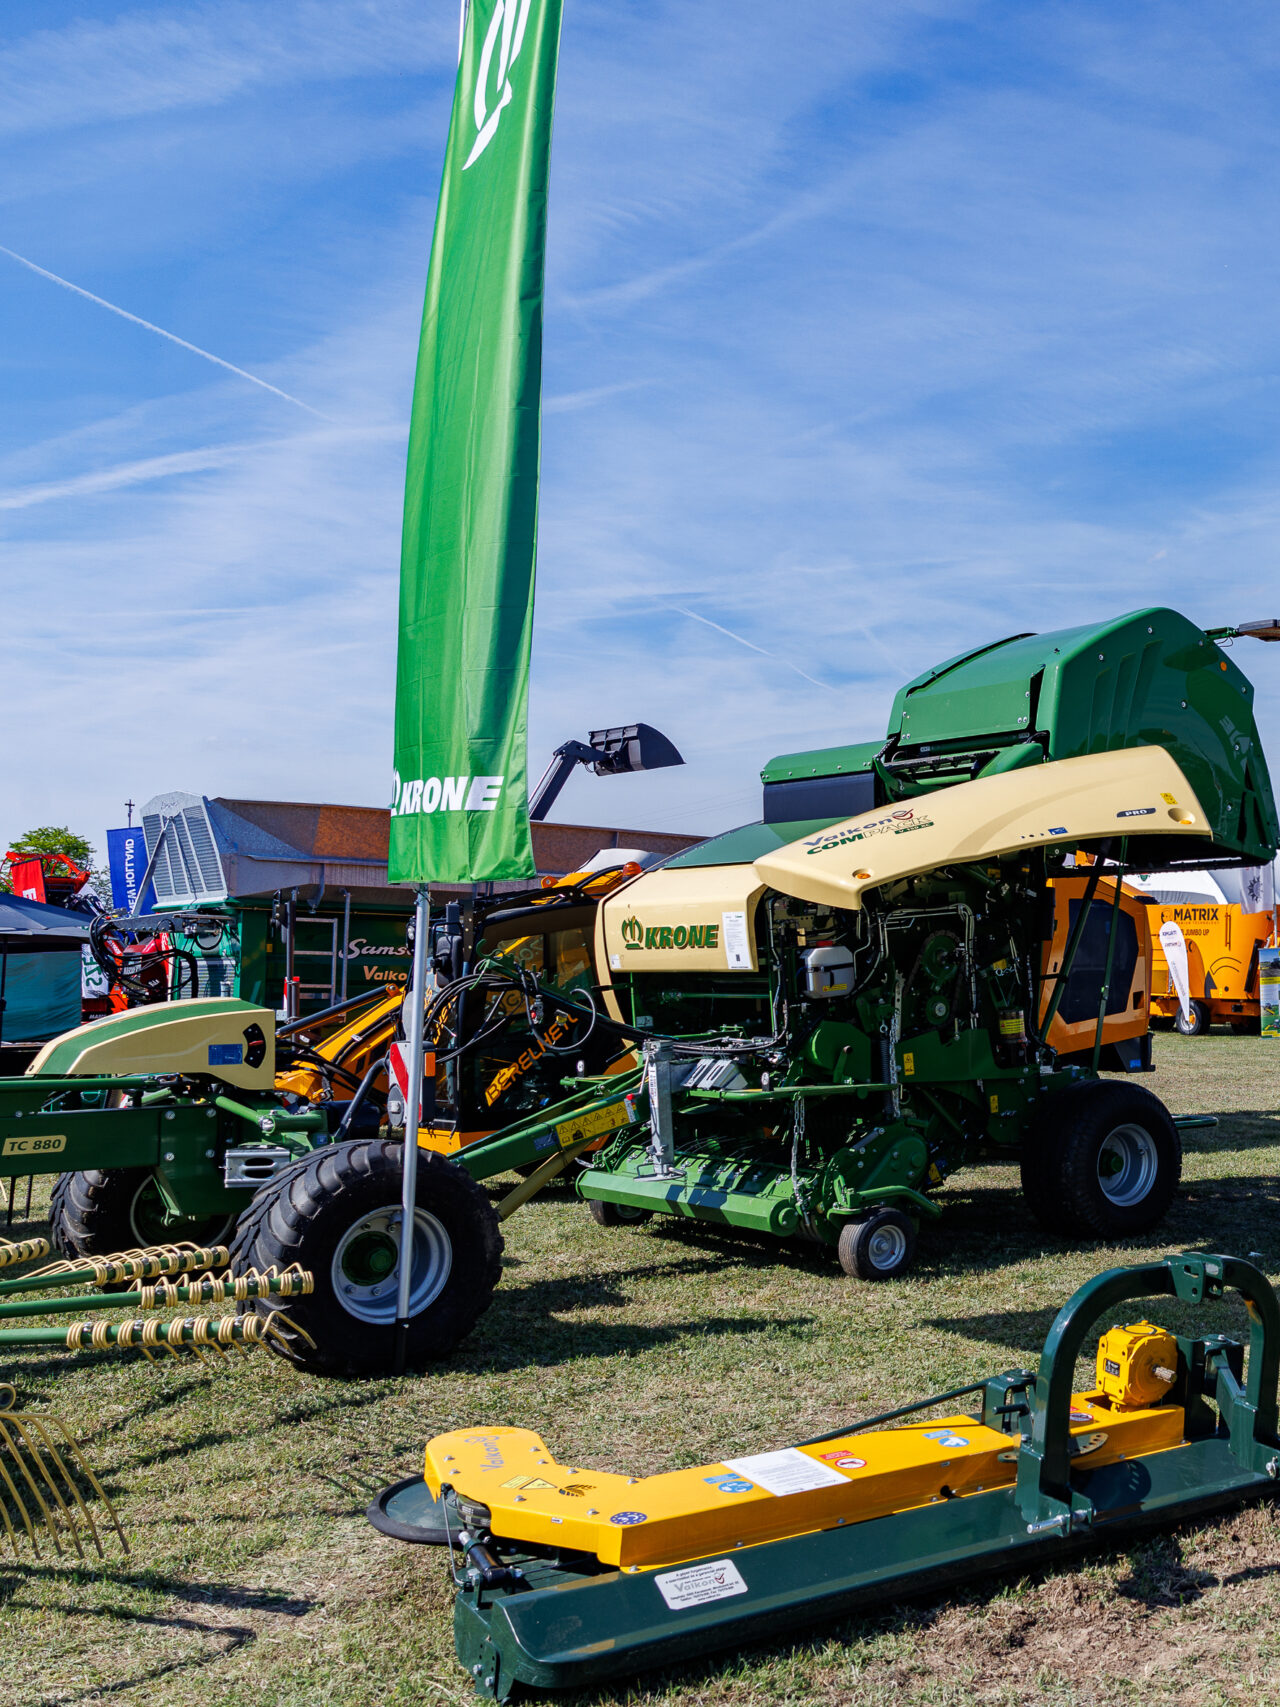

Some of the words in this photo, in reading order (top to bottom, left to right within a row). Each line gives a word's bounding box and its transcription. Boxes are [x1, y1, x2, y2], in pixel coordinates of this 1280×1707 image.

[398, 775, 505, 816] KRONE
[802, 818, 892, 846] Valkon
[1174, 908, 1219, 921] MATRIX
[645, 924, 720, 949] KRONE
[1185, 928, 1202, 936] JUMBO
[1203, 928, 1210, 936] UP
[338, 938, 412, 960] Sams
[363, 965, 407, 981] Valko
[9, 1141, 28, 1151] TC
[32, 1139, 61, 1150] 880
[480, 1441, 504, 1472] Valkon
[674, 1579, 716, 1592] Valkon
